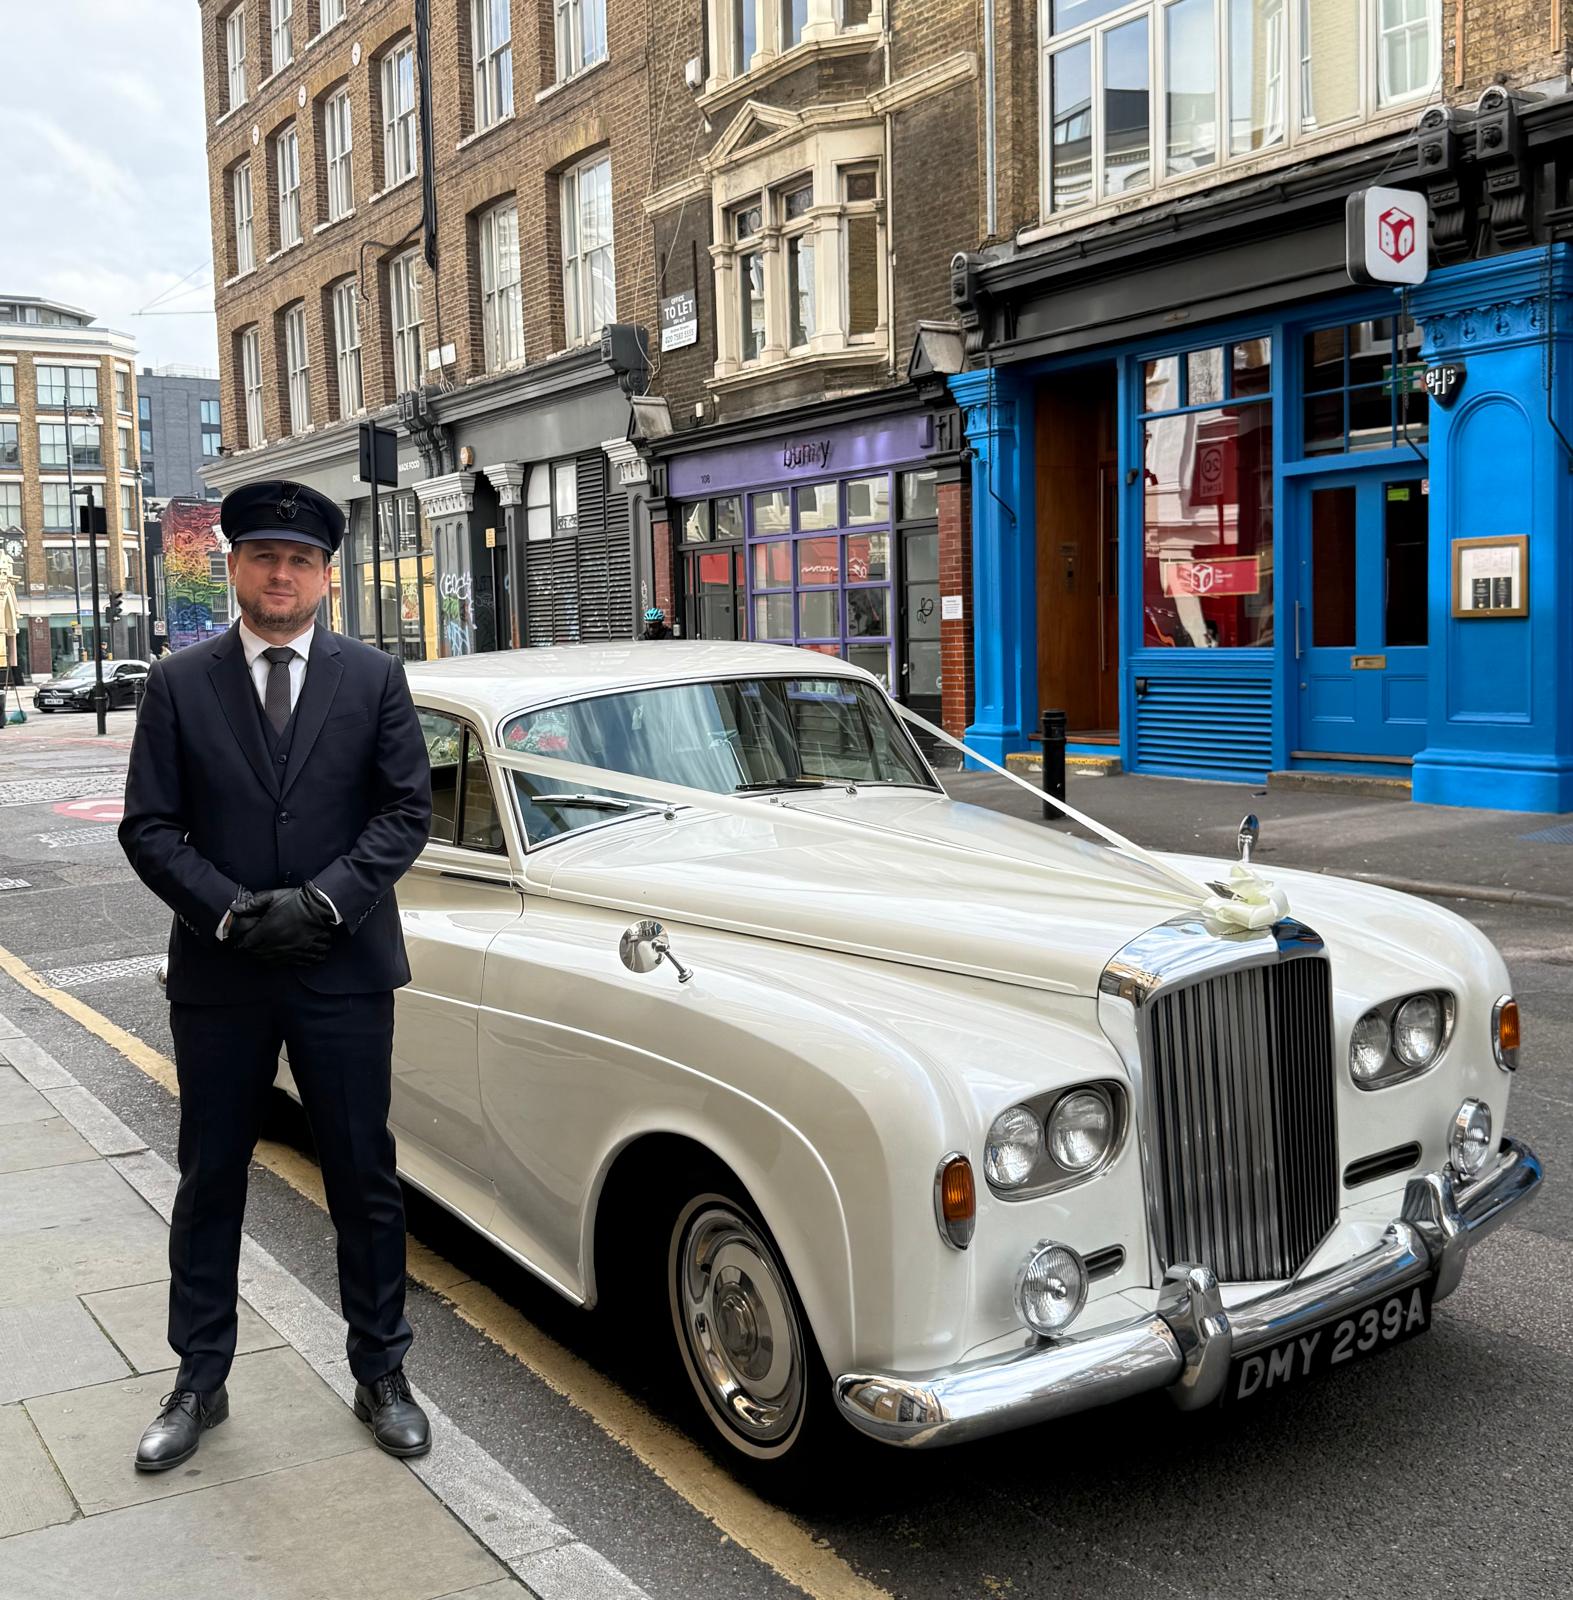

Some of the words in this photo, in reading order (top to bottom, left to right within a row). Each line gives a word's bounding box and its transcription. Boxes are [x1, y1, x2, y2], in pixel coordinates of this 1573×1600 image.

[664, 306, 676, 320] TO
[678, 300, 693, 316] LET
[1238, 1331, 1322, 1400] DMY
[1331, 1287, 1425, 1365] 239A
